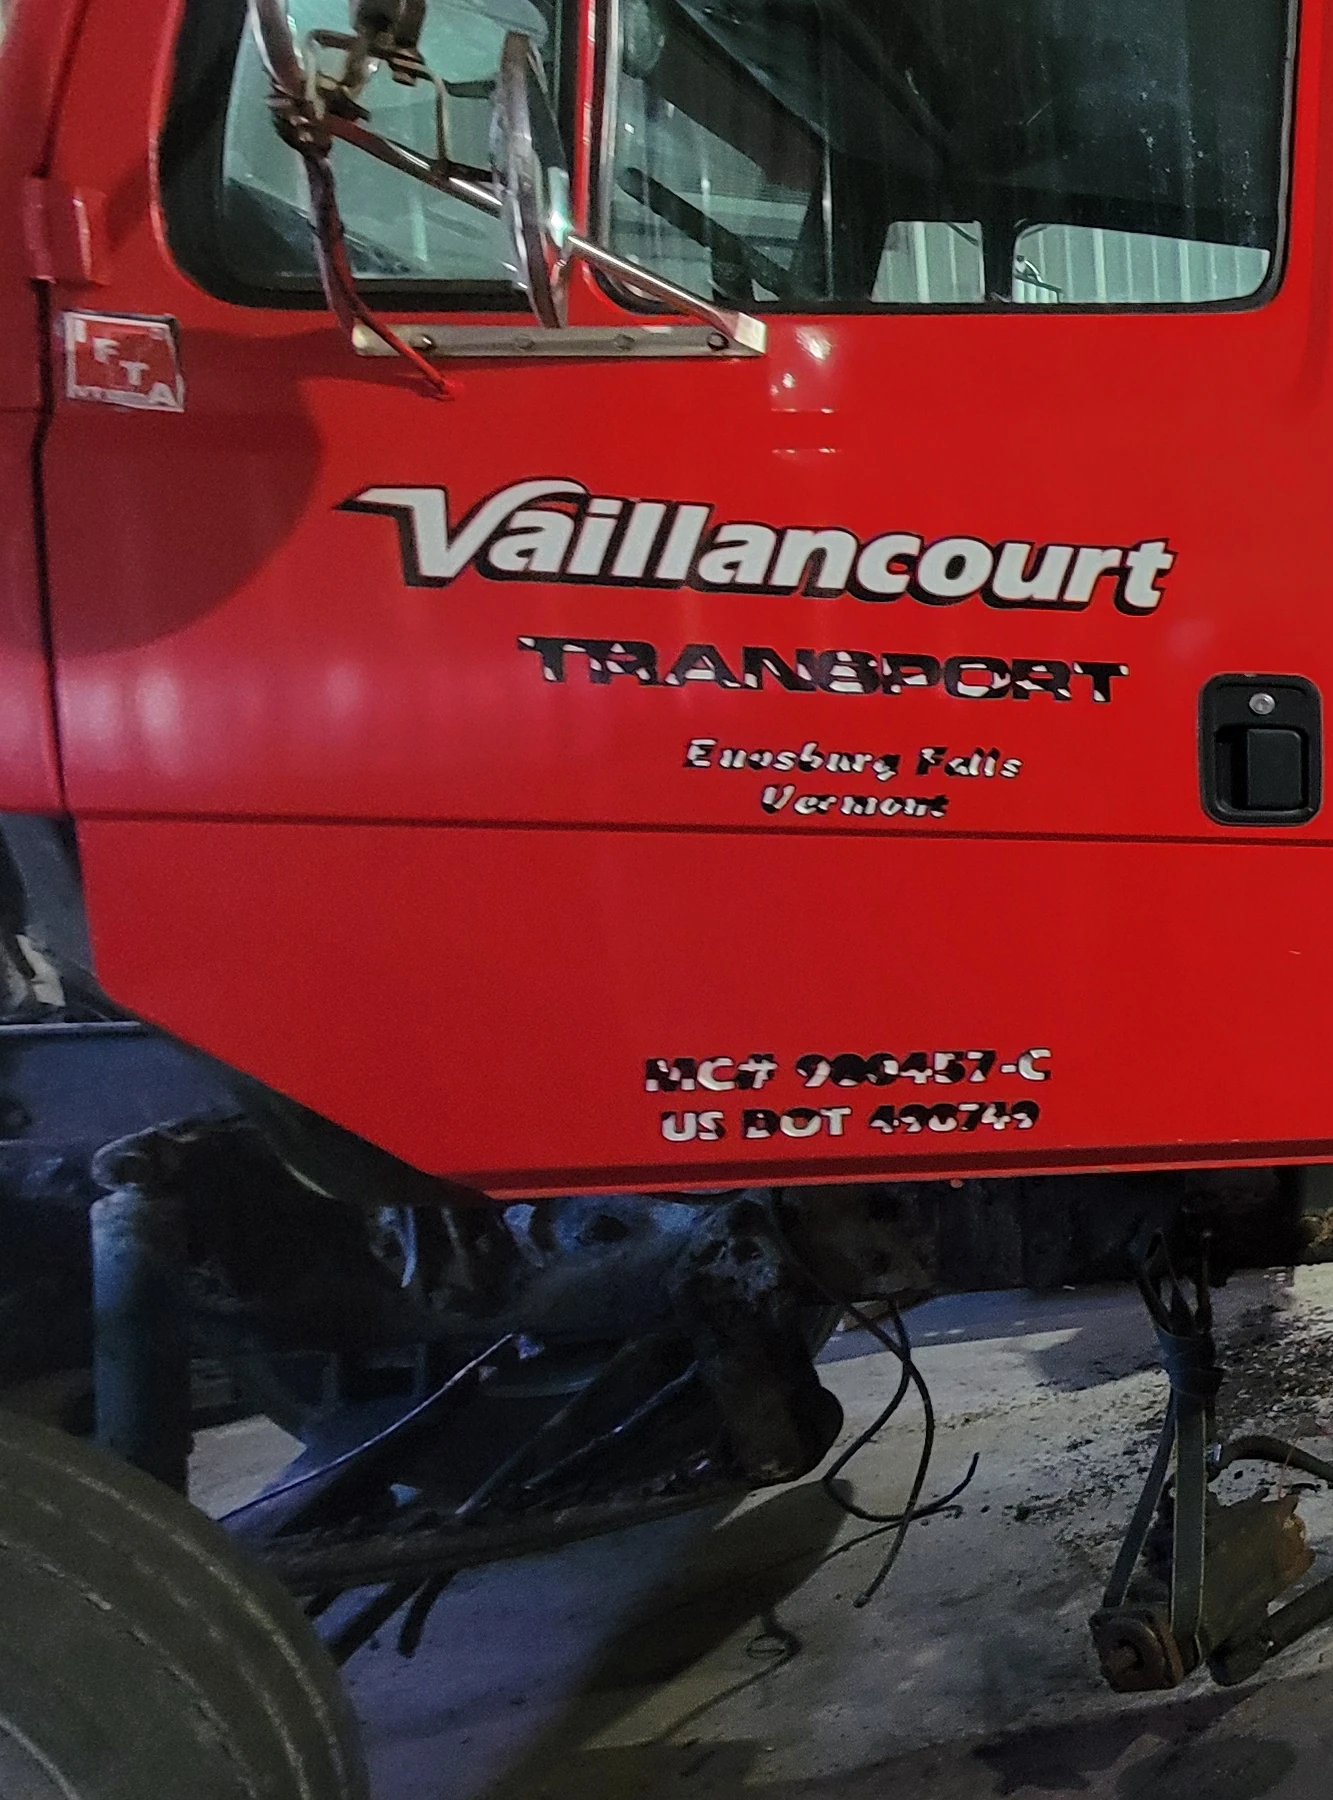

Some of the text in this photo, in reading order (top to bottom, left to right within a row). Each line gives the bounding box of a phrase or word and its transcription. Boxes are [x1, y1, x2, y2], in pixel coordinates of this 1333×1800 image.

[334, 476, 1177, 614] Vaillancourt
[517, 635, 1130, 704] TRANSPORT
[915, 746, 1024, 779] Falls
[761, 783, 949, 818] Vermont
[645, 1053, 778, 1093] MC#
[660, 1109, 726, 1143] US
[741, 1105, 853, 1140] DOT
